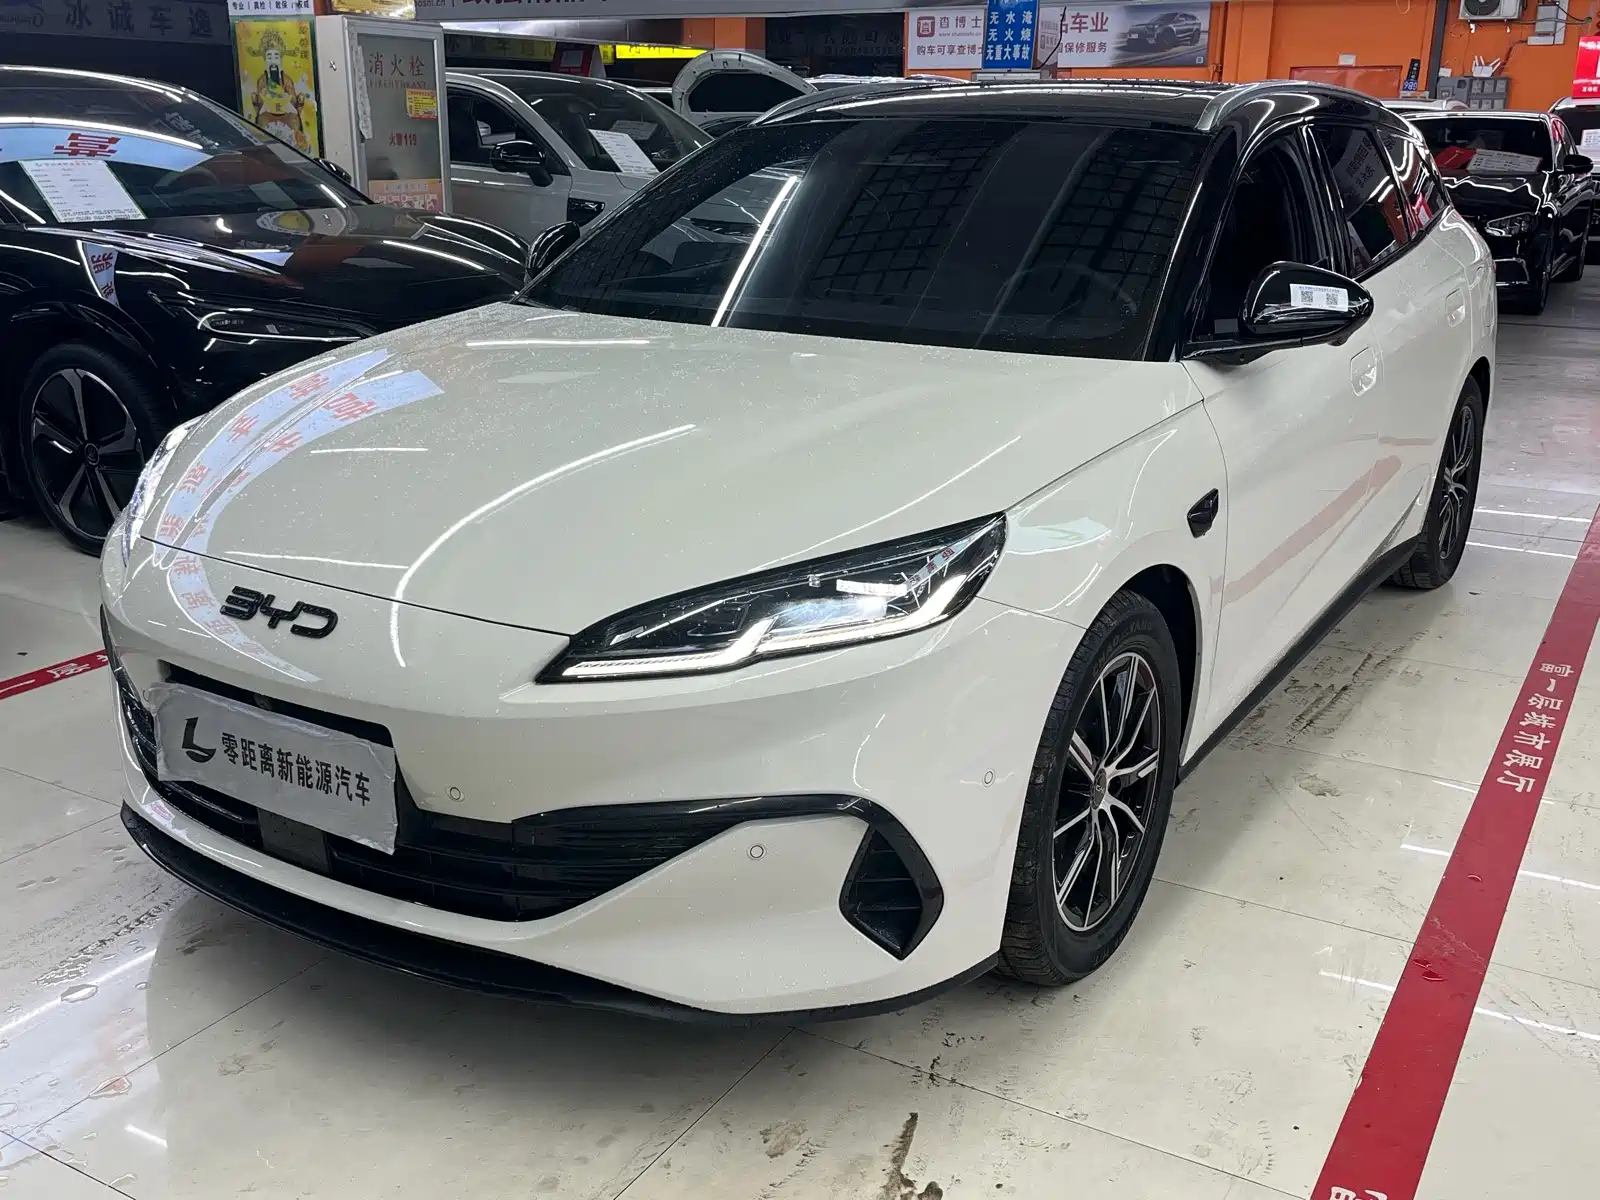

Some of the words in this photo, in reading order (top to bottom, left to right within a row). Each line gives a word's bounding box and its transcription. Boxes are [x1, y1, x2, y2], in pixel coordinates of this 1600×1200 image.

[939, 16, 982, 28] 查博士
[989, 10, 1033, 25] 无水淹
[987, 28, 1031, 42] 无火烧
[985, 44, 1031, 61] 无重大事故
[368, 51, 428, 77] 消火栓
[219, 585, 339, 639] BYD
[1497, 663, 1575, 793] 富一层城市展厅
[221, 731, 371, 807] 零距离新能源汽车
